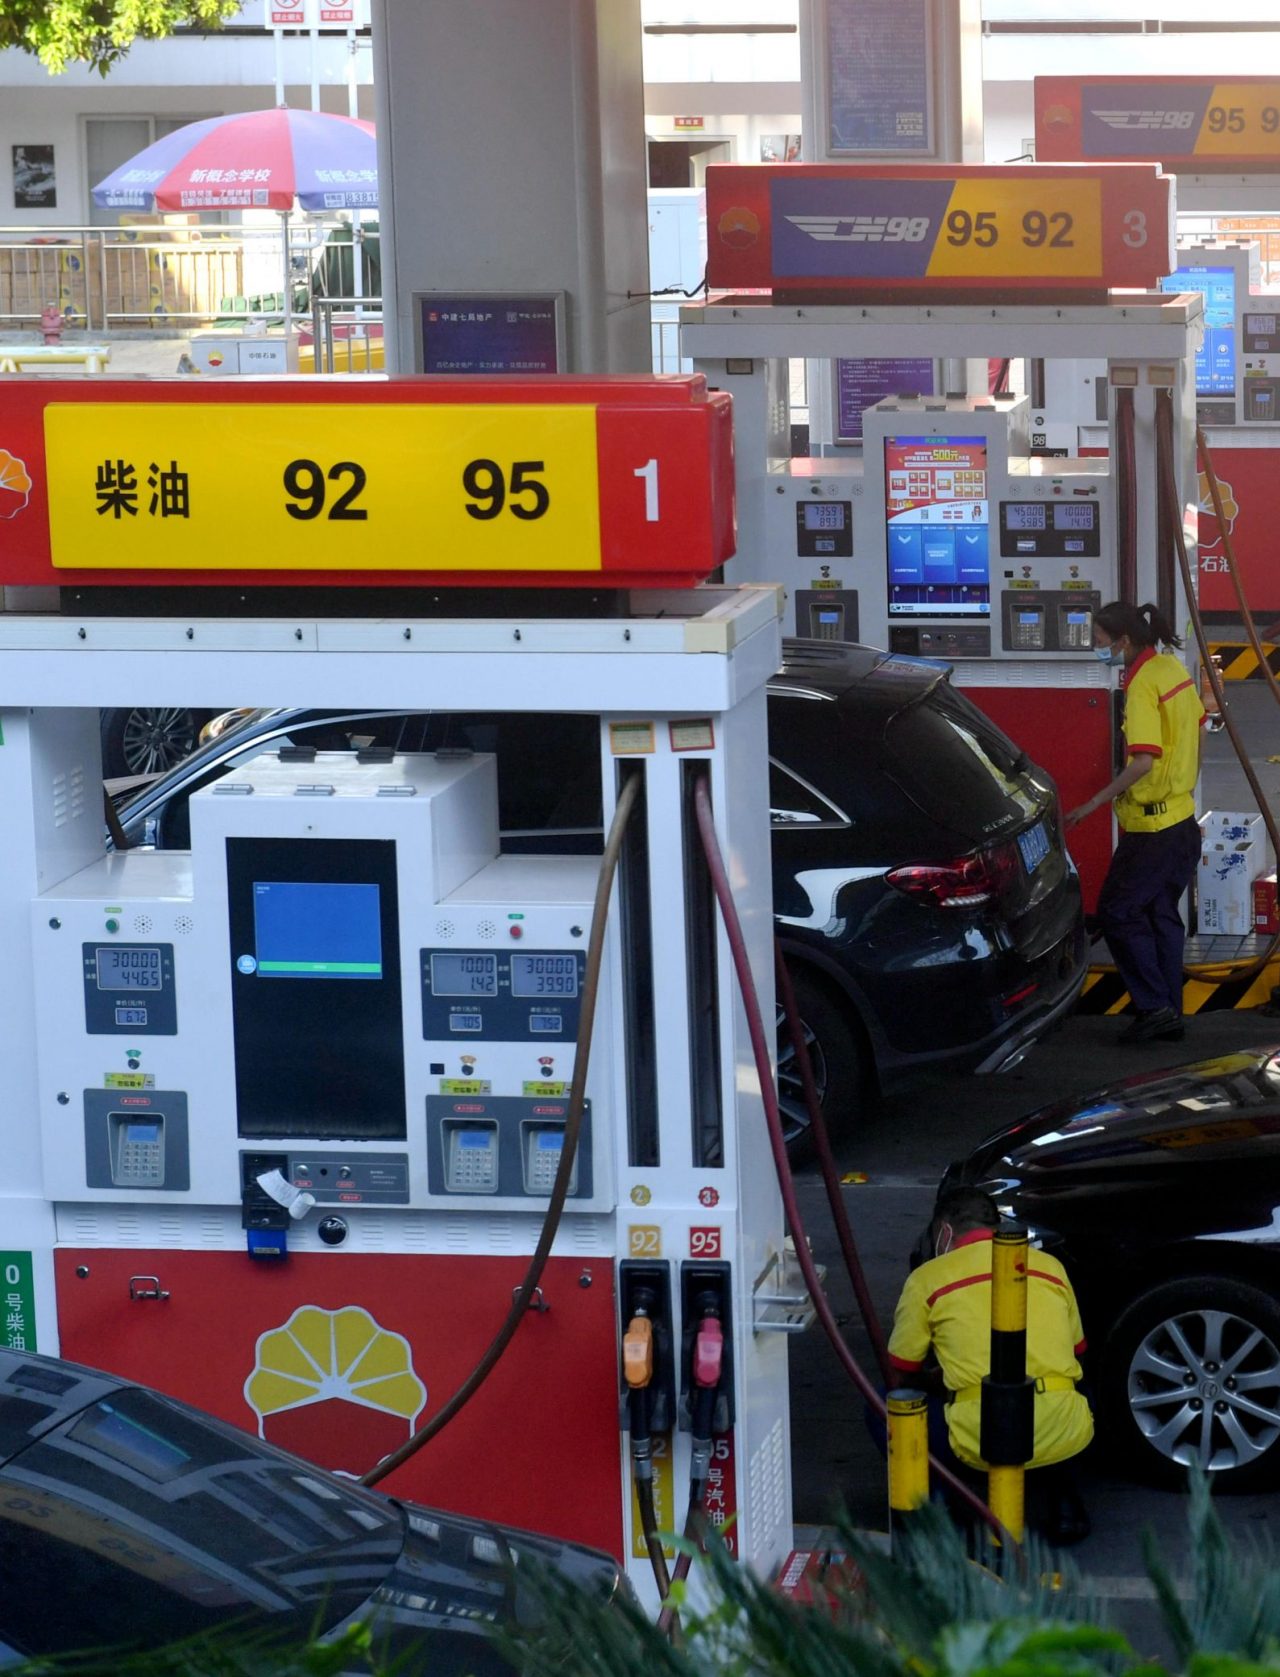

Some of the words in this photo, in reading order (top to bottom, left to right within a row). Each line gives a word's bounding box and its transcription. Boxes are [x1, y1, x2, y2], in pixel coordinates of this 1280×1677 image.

[1110, 109, 1195, 130] CN98
[1207, 106, 1246, 134] 95
[189, 169, 272, 183] 新概念学校
[315, 169, 378, 183] 新概念学
[805, 215, 930, 244] CN98
[945, 210, 999, 248] 95
[1021, 211, 1074, 249] 92
[1122, 211, 1148, 248] 3
[442, 313, 493, 321] 中建七局地产
[1033, 436, 1045, 446] 98
[95, 459, 190, 520] 柴油
[282, 458, 368, 520] 92
[462, 459, 550, 520] 95
[634, 458, 660, 521] 1
[631, 1231, 658, 1252] 92
[691, 1233, 719, 1254] 95
